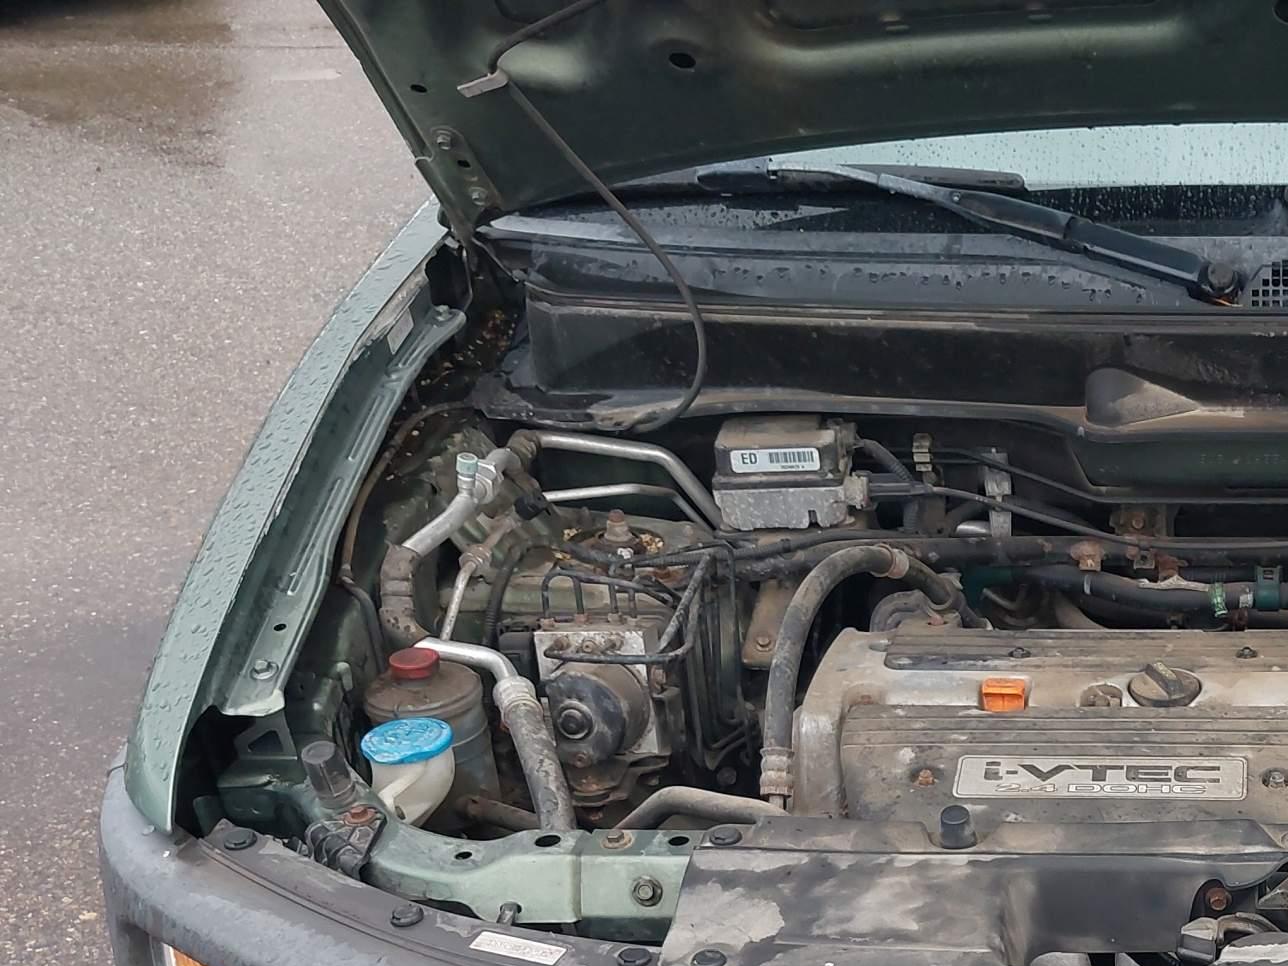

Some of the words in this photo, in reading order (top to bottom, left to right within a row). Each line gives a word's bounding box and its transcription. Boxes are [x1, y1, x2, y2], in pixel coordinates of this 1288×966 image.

[741, 452, 758, 465] ED
[983, 761, 1221, 783] i-VTEC
[994, 783, 1058, 793] 2.4
[1067, 784, 1206, 795] DOHC
